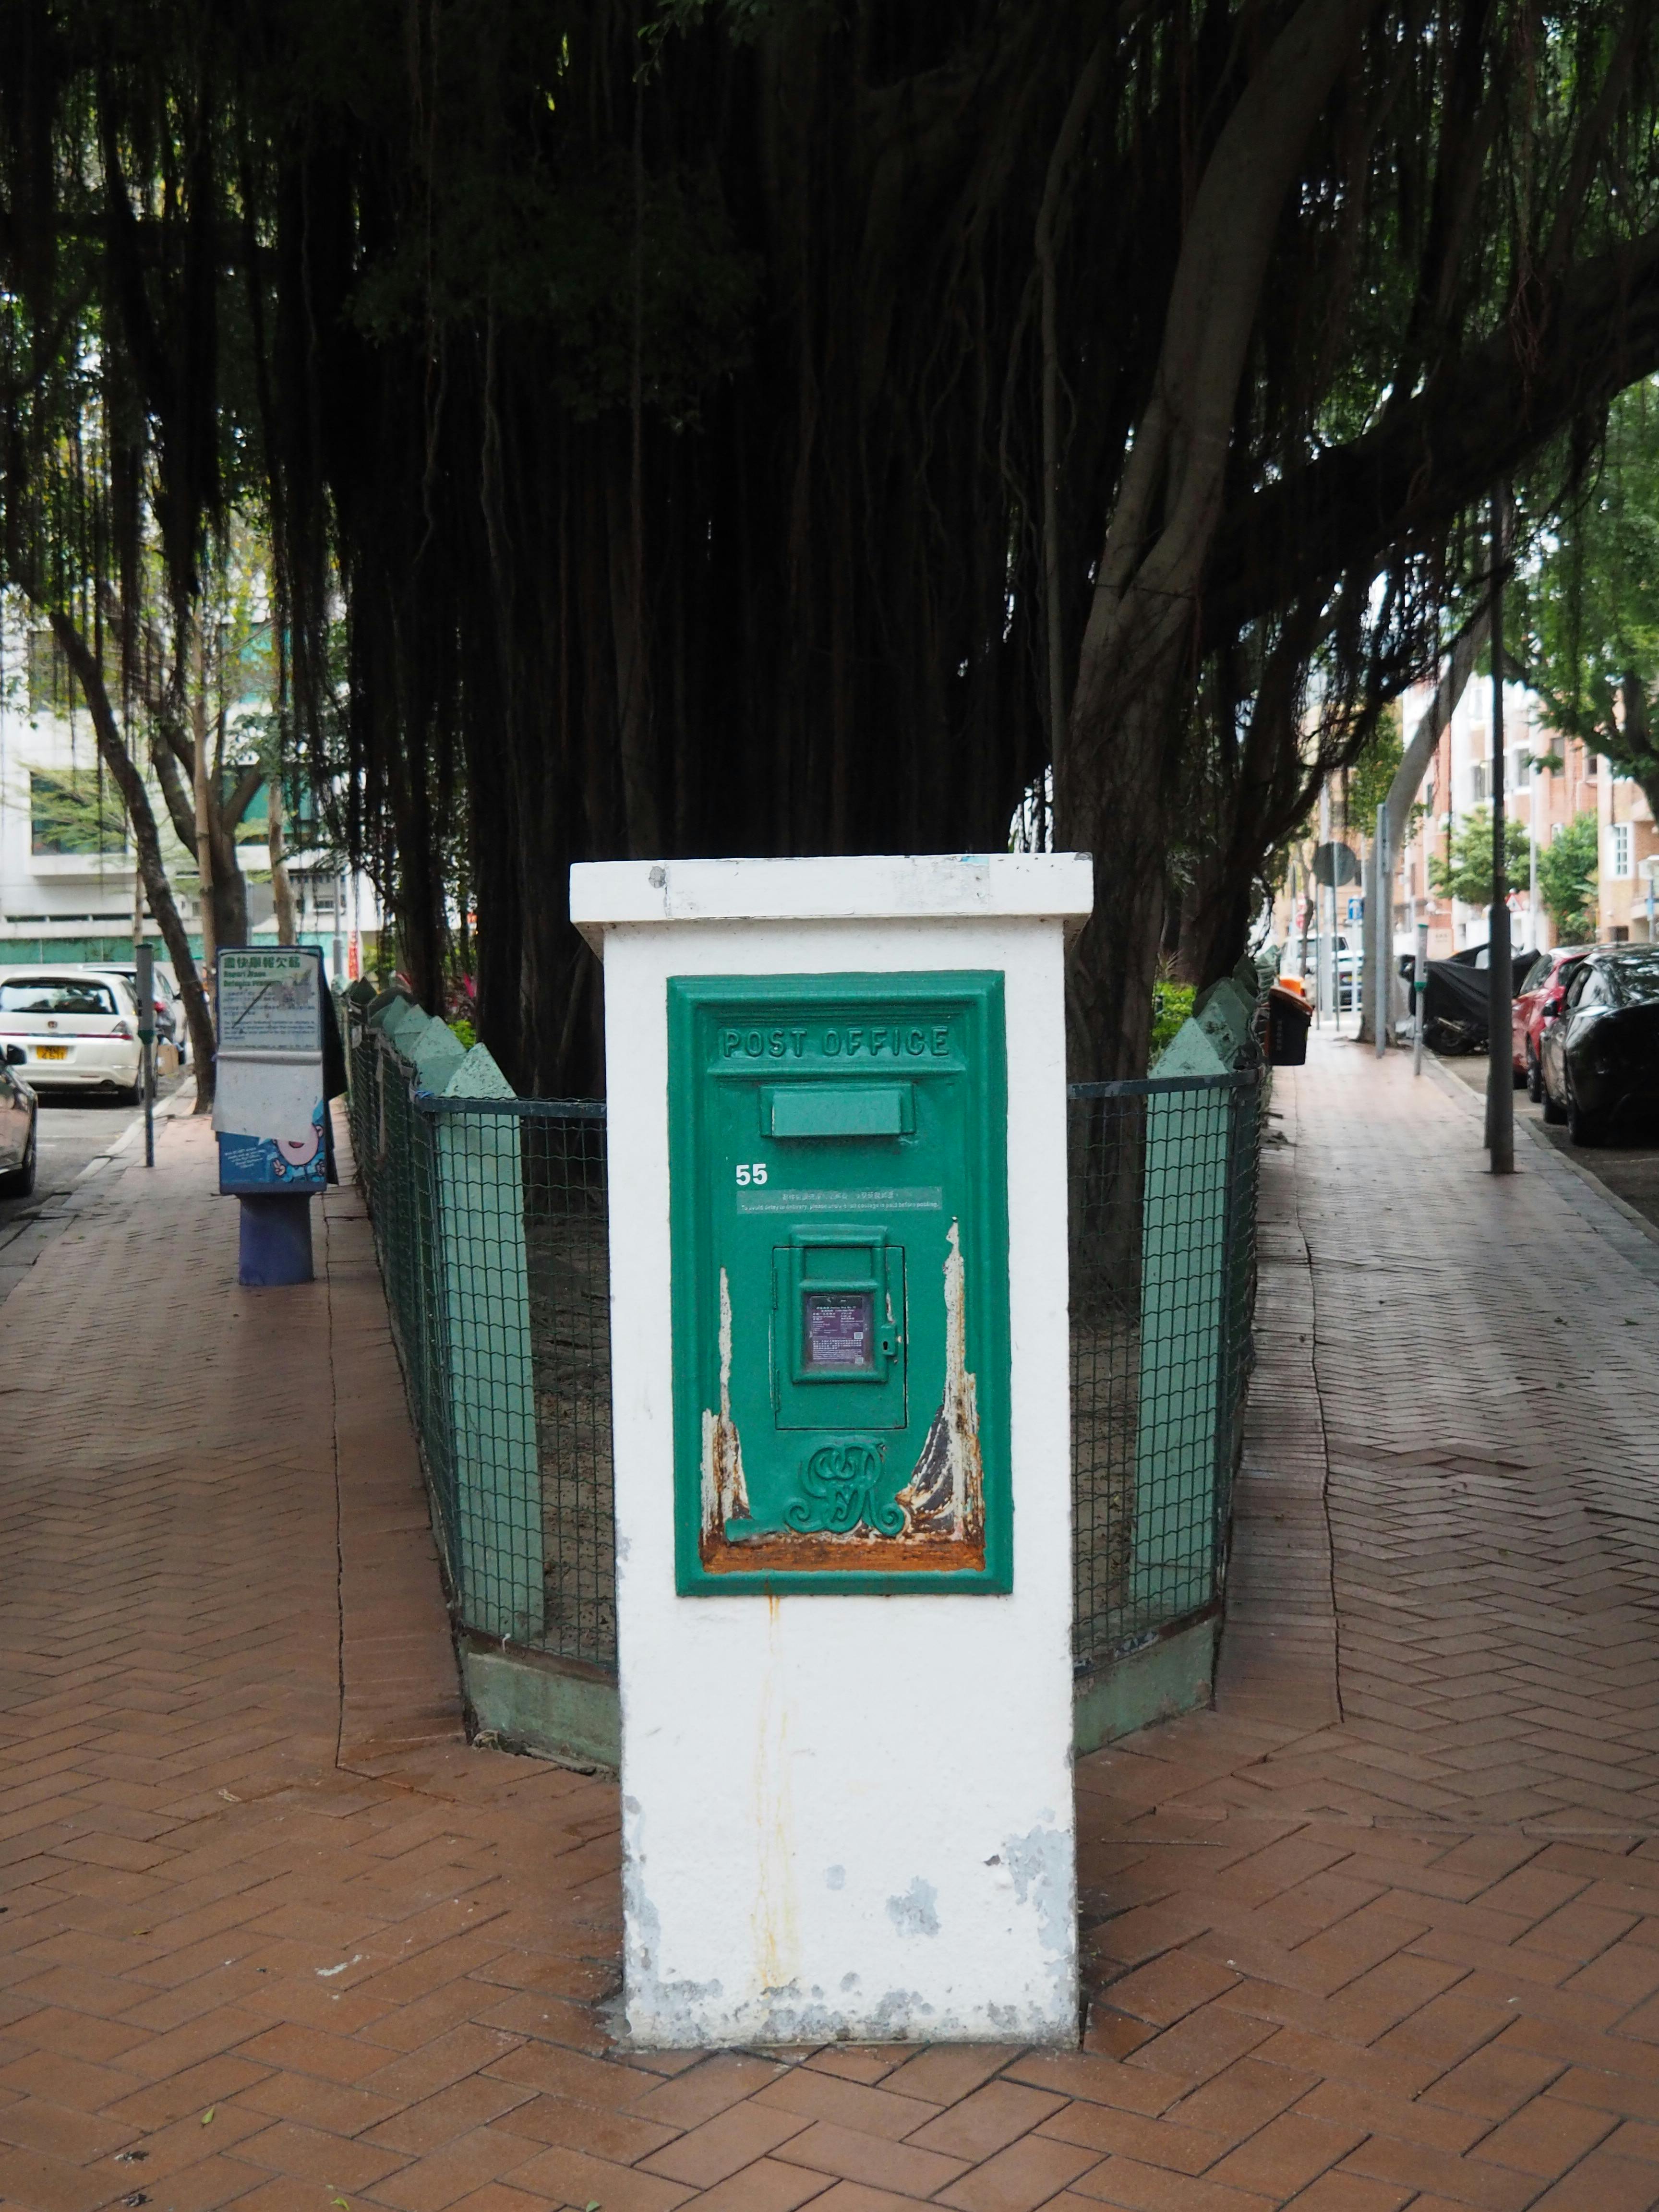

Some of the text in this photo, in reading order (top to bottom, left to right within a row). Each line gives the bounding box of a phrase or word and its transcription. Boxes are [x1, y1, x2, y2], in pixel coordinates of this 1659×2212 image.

[722, 1026, 950, 1058] POST OFFICE
[736, 1163, 768, 1186] 55
